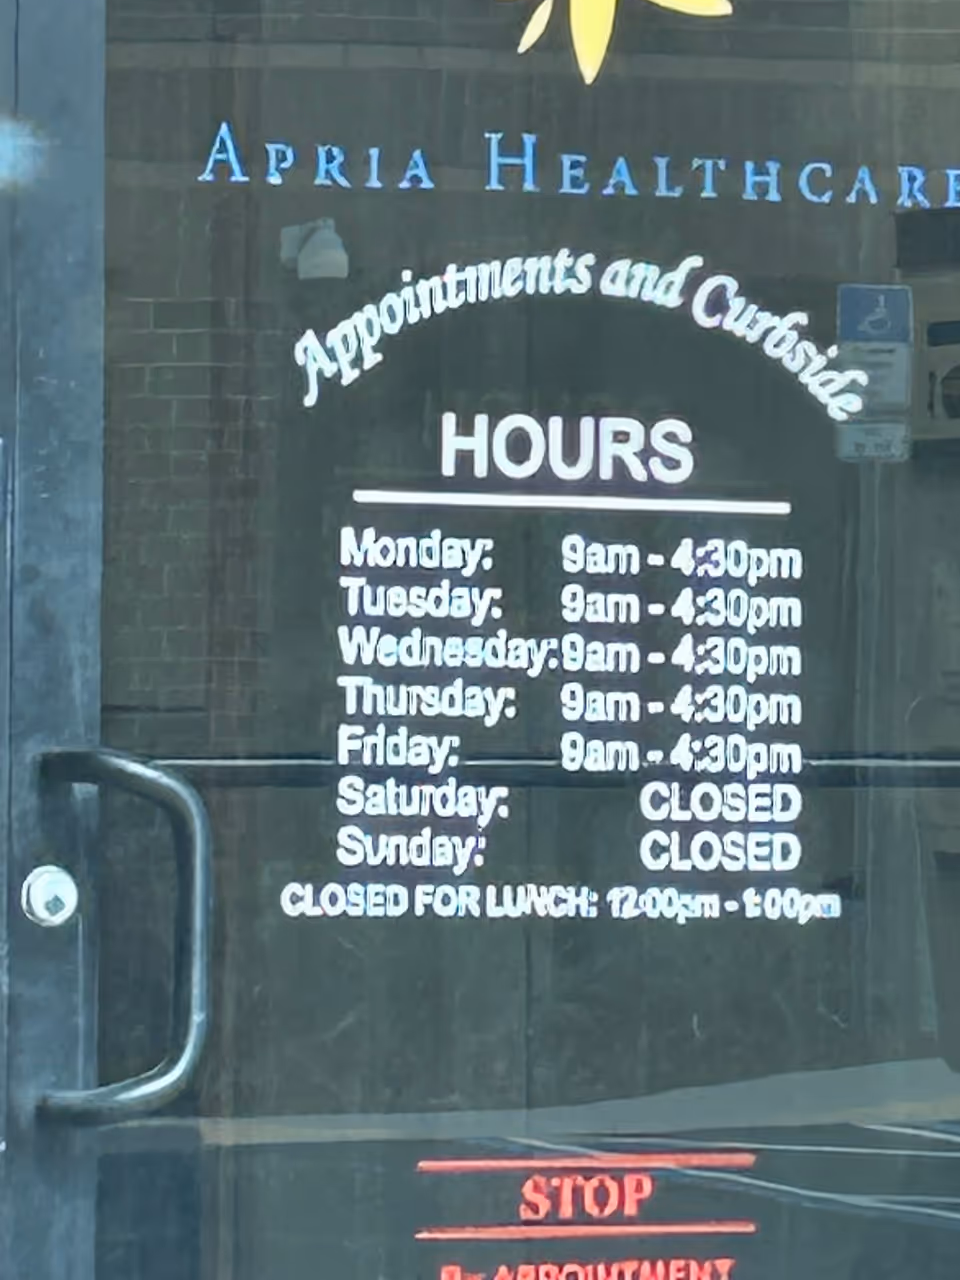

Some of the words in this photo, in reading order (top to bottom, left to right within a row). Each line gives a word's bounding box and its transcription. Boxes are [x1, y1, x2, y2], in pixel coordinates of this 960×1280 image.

[198, 120, 434, 189] APRIA
[294, 247, 596, 407] Appointments
[599, 255, 704, 308] and
[692, 275, 869, 421] Curbside
[441, 411, 694, 484] HOURS
[340, 526, 493, 578] Monday:
[561, 533, 640, 573] 9am
[670, 535, 802, 586] 4:30pm
[339, 575, 503, 627] Tuesday:
[561, 583, 640, 623] 9am
[670, 585, 802, 636] 4:30pm
[337, 625, 559, 678] Wednesday:
[561, 632, 640, 672] 9am
[670, 634, 802, 685] 4:30pm
[336, 675, 516, 728] Thursday:
[561, 681, 640, 721] 9am
[670, 683, 802, 734] 4:30pm
[336, 722, 461, 775] Friday:
[561, 731, 640, 771] 9am
[670, 733, 802, 784] 4:30pm
[335, 774, 509, 833] Saturday:
[639, 780, 802, 823] CLOSED
[335, 824, 487, 876] Sunday:
[639, 829, 802, 872] CLOSED
[280, 882, 409, 918] CLOSED
[414, 884, 481, 918] FOR
[486, 883, 599, 918] LUNCH:
[519, 1173, 653, 1219] STOP
